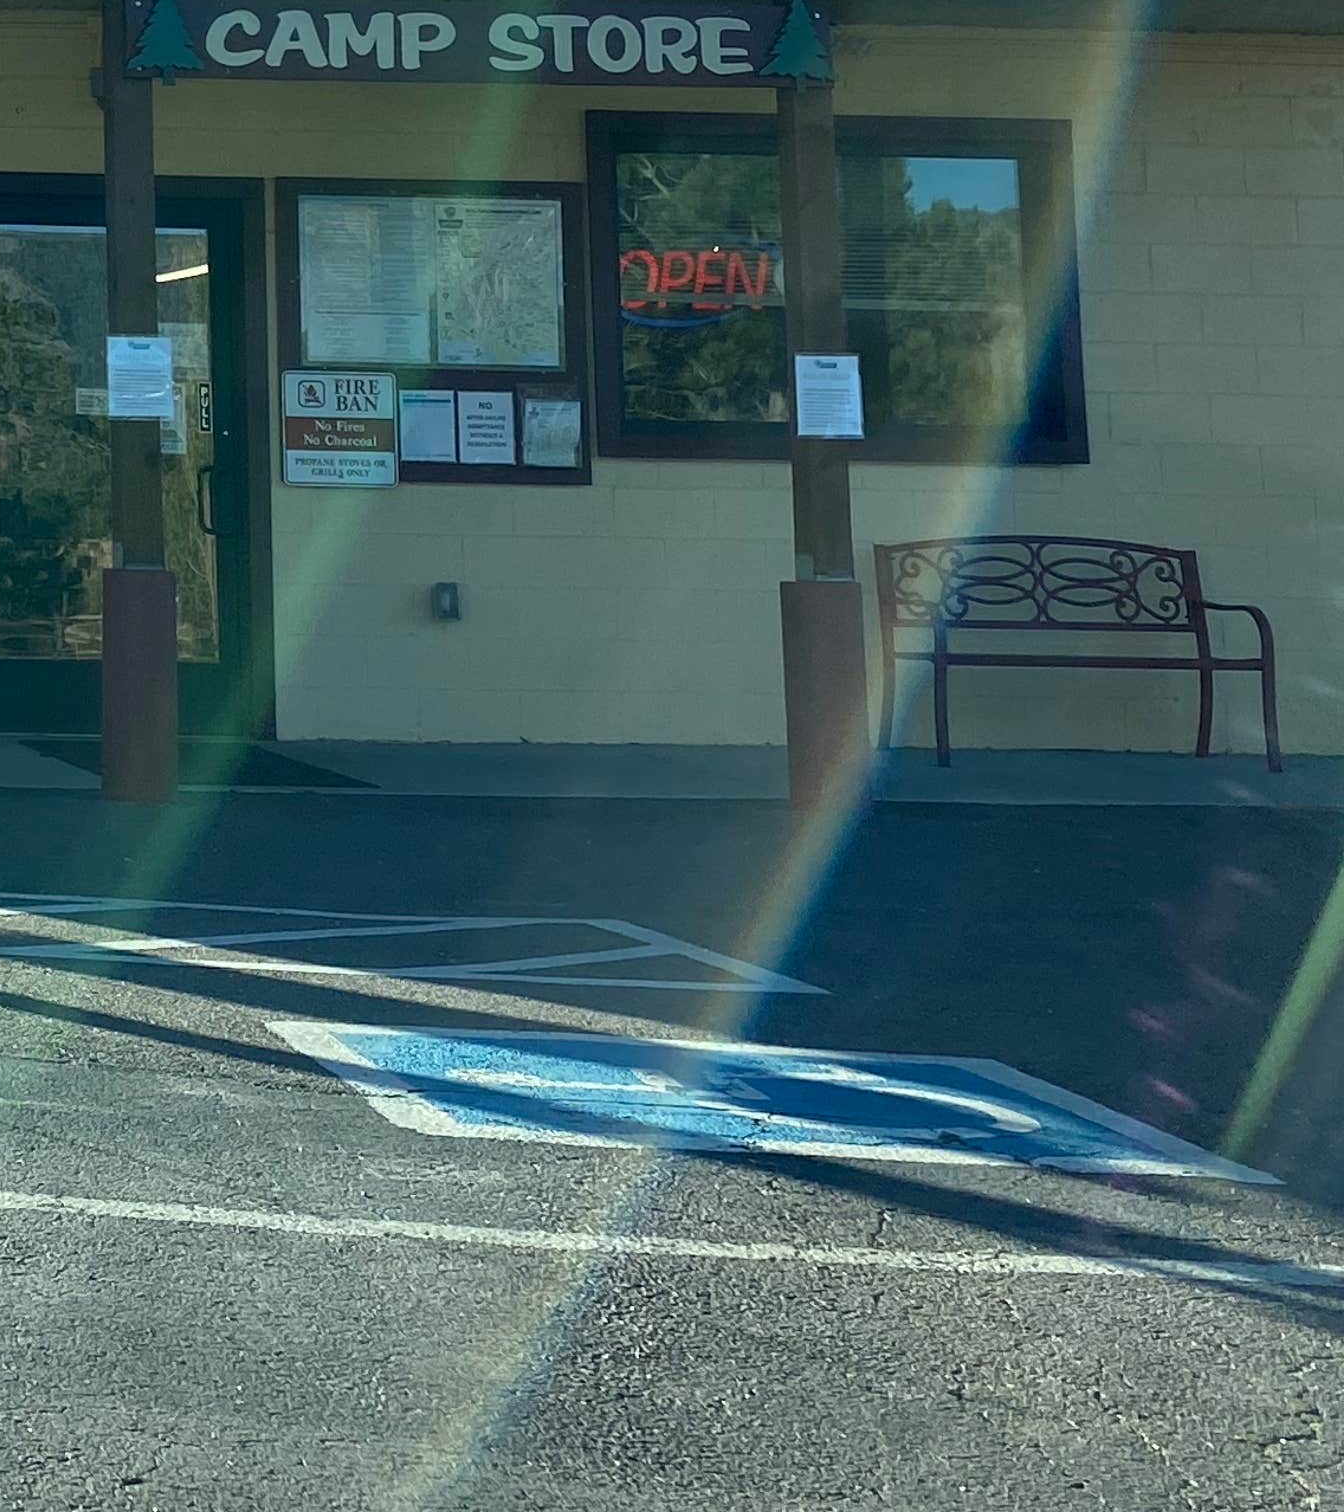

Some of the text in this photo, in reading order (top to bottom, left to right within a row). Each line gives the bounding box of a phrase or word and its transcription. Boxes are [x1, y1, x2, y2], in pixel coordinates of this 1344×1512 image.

[205, 9, 756, 74] CAMP STORE
[620, 249, 769, 311] OPEN
[334, 379, 381, 395] FIRE
[200, 387, 210, 429] PULL
[336, 395, 378, 412] BAN
[478, 401, 493, 410] NO
[315, 420, 365, 432] No Fires
[303, 434, 377, 447] No Charcoal
[346, 469, 370, 477] ONLY
